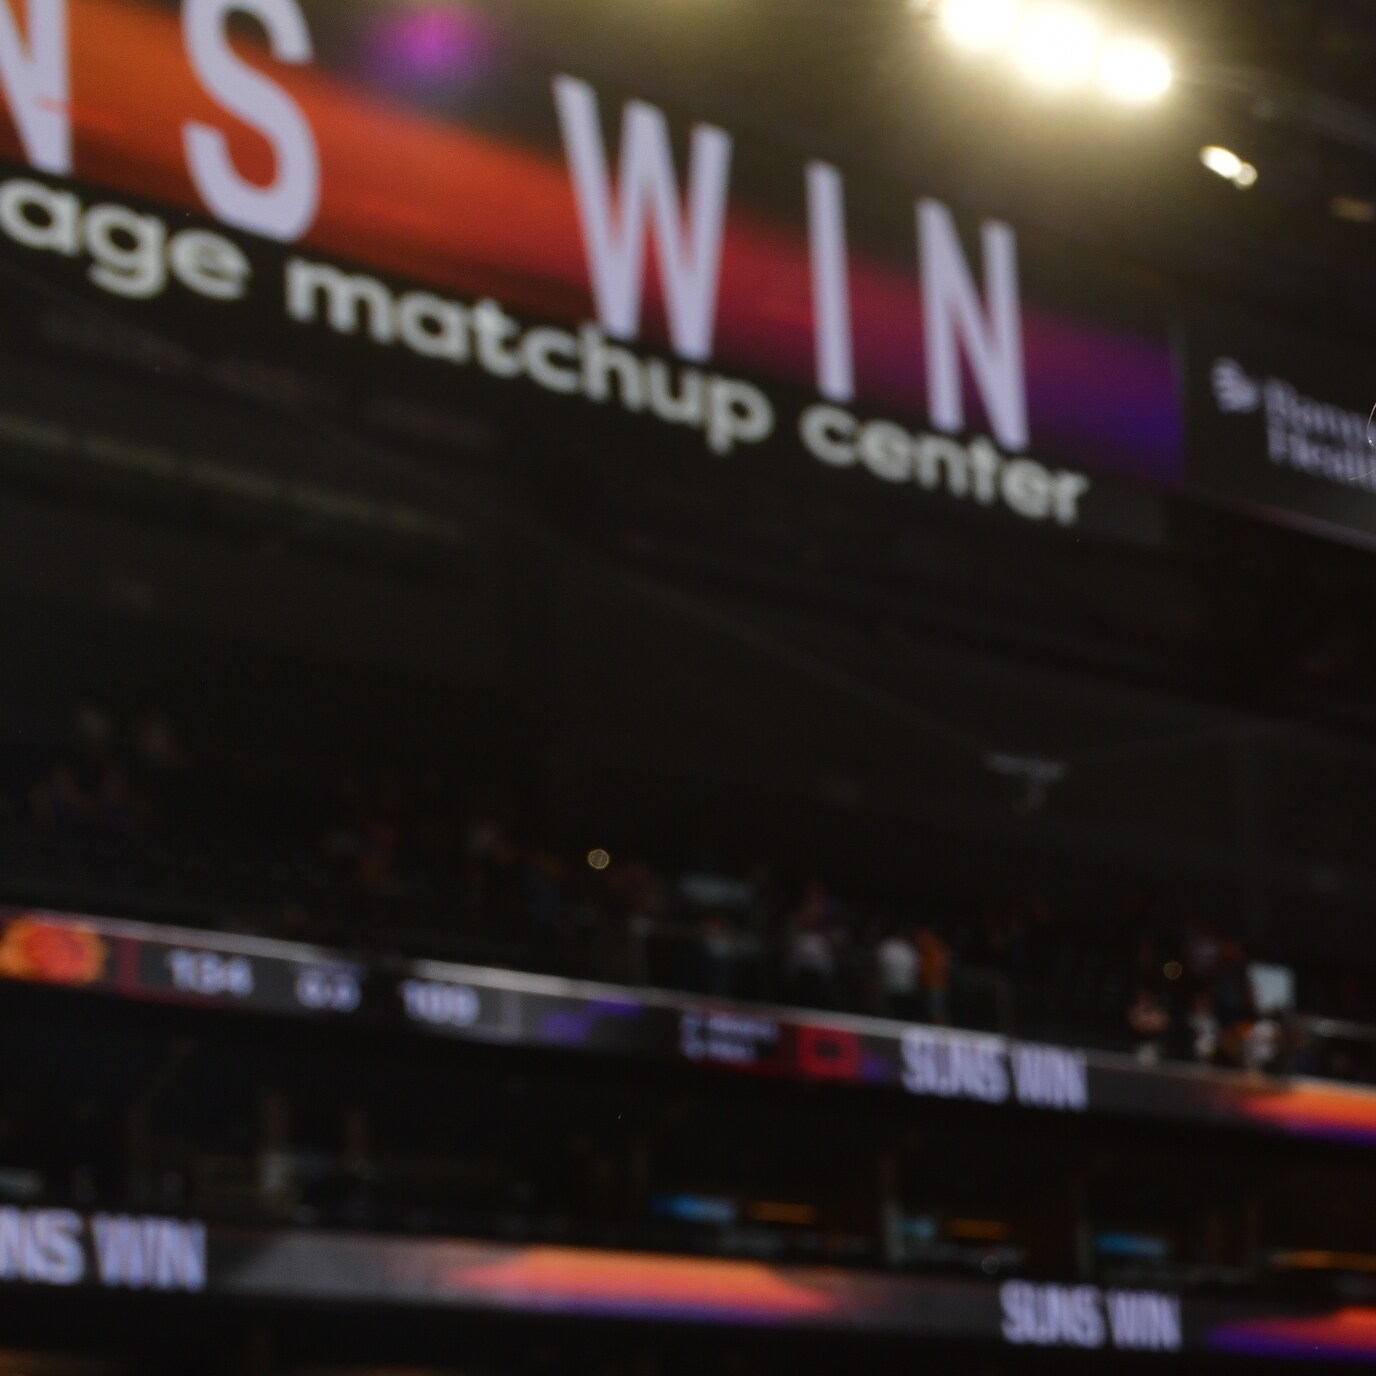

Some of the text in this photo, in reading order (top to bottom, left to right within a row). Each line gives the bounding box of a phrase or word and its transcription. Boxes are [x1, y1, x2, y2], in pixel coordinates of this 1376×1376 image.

[0, 178, 1090, 525] age matchup center
[552, 73, 1030, 452] WIN
